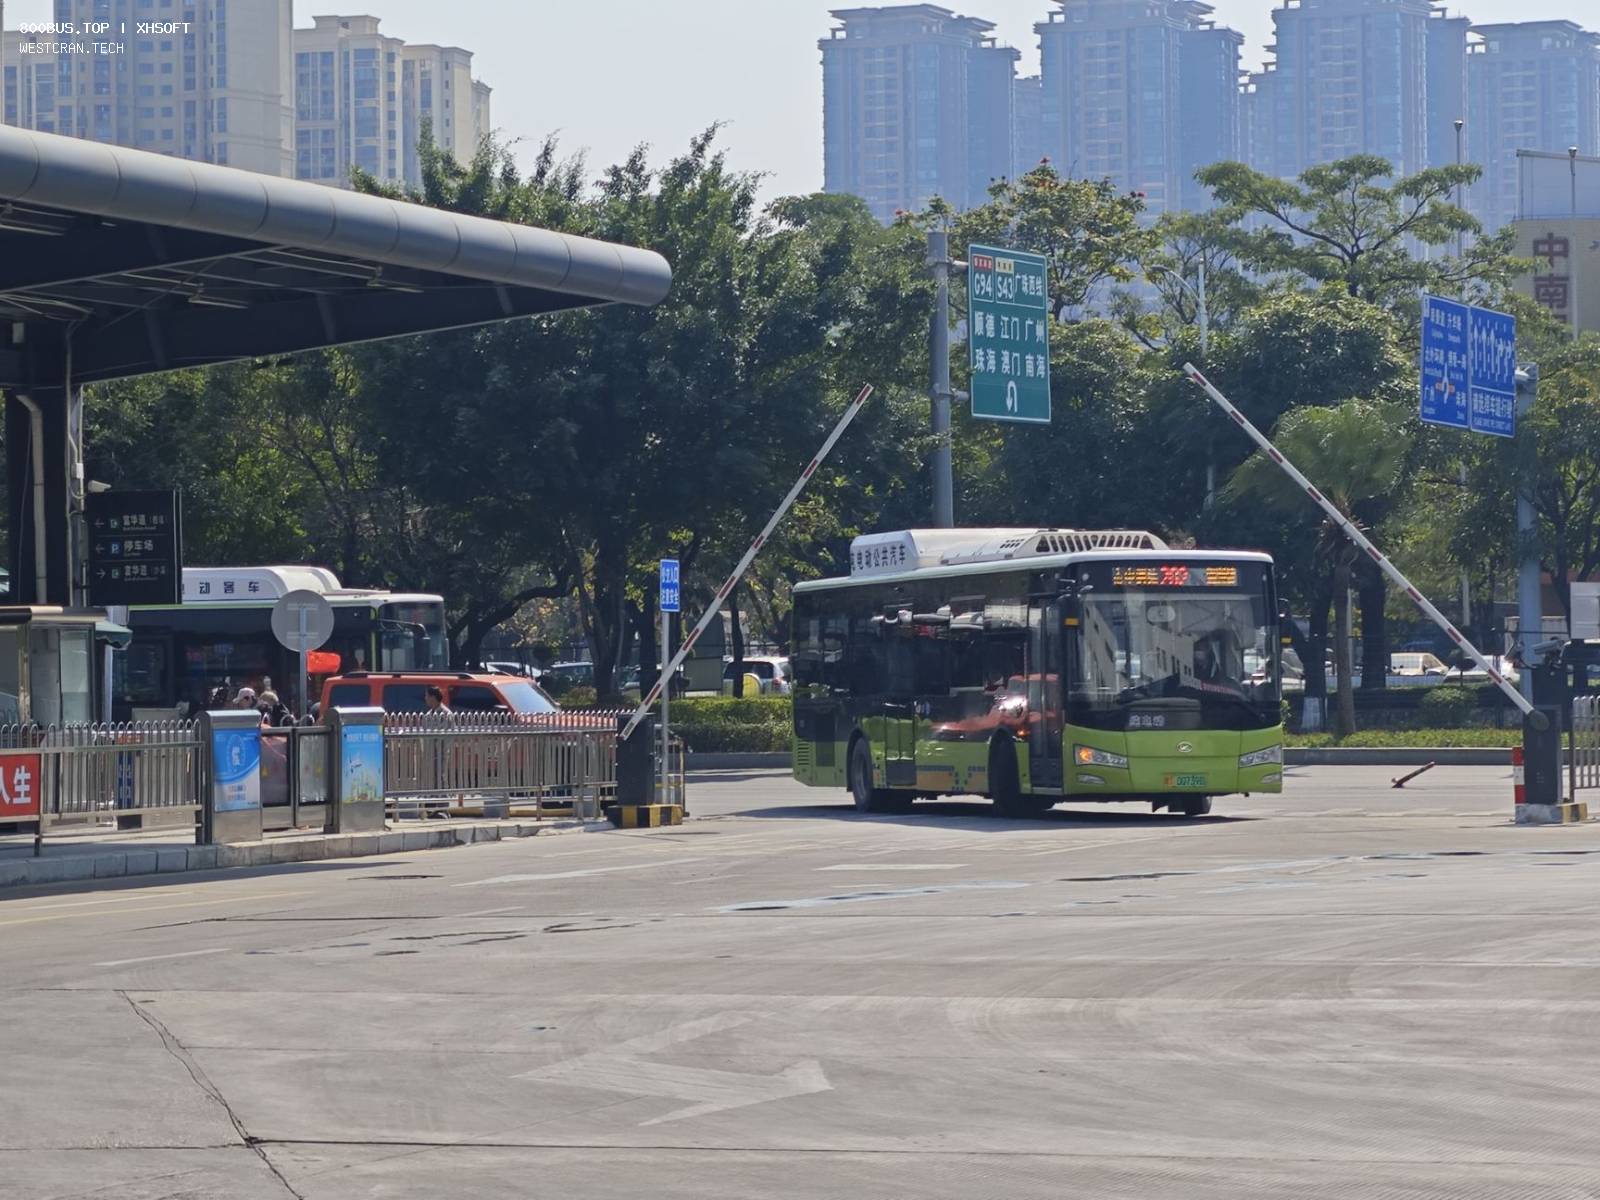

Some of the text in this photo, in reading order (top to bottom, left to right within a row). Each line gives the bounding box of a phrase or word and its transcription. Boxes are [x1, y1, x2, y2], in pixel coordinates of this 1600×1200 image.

[974, 272, 1043, 300] G94 S43 广珠西线
[974, 310, 1045, 343] 顺德 江门 广州
[975, 347, 1045, 378] 珠海 澳门 南海
[124, 540, 154, 552] 停车场
[182, 580, 260, 594] 动客车
